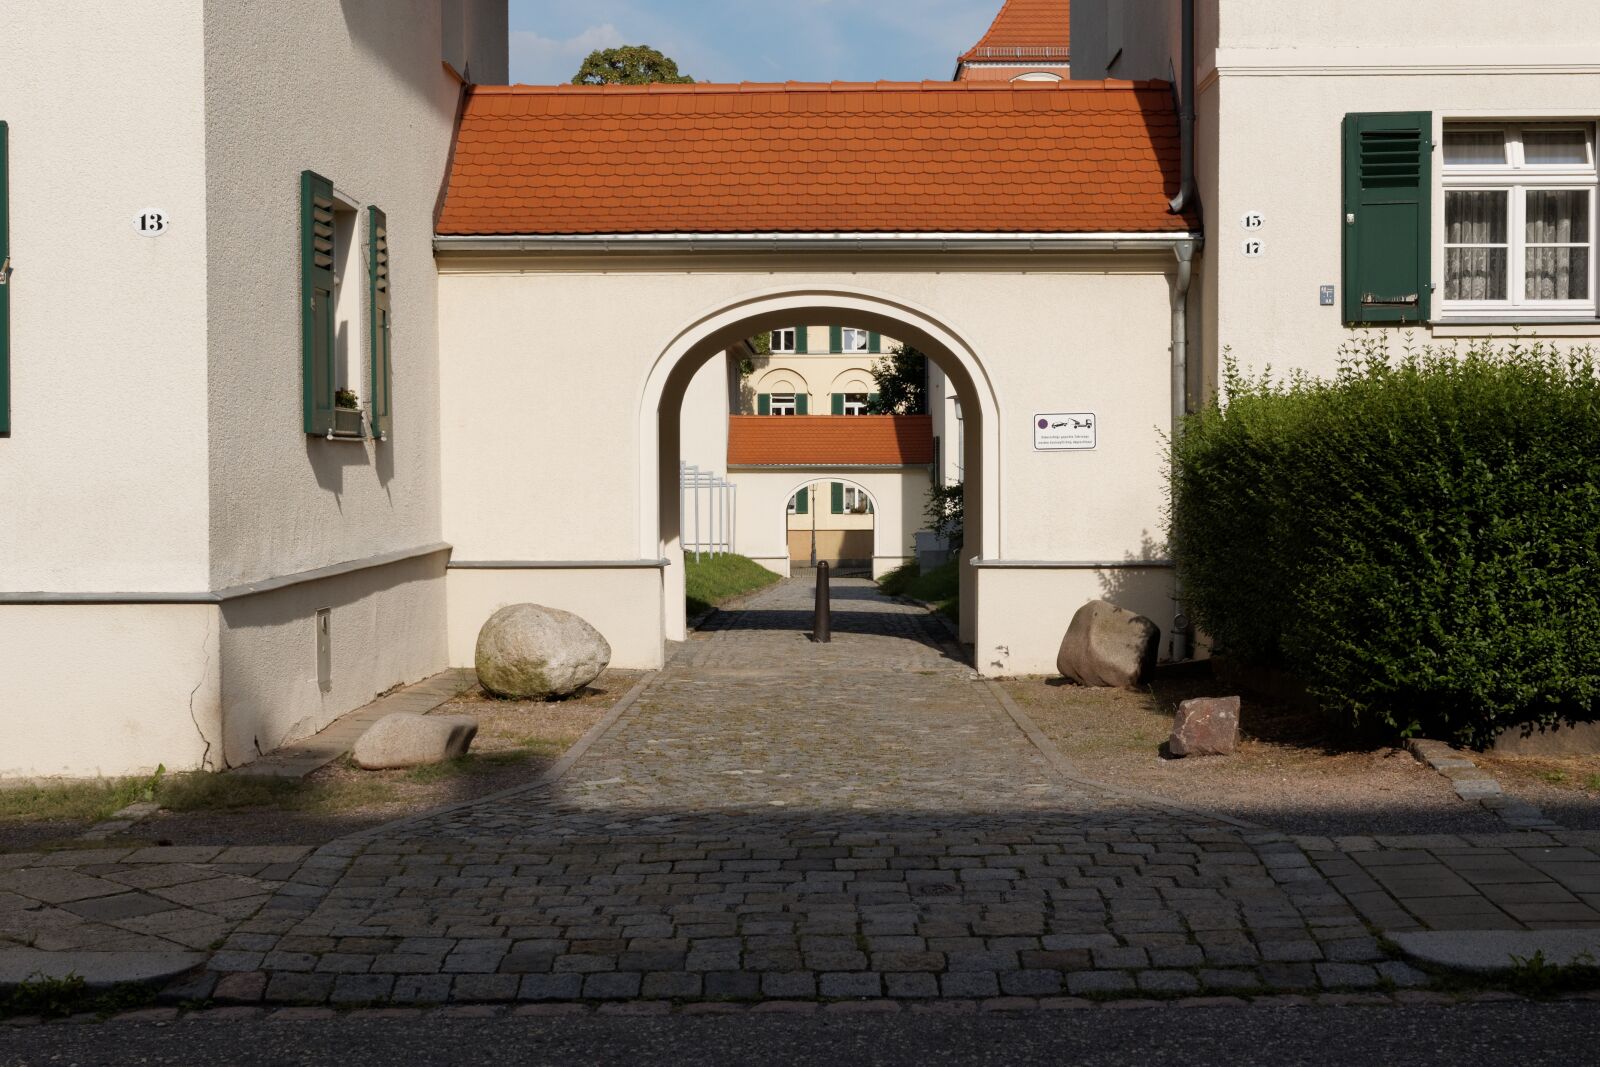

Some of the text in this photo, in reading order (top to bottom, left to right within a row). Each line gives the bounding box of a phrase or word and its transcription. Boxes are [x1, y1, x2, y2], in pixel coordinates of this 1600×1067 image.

[139, 213, 163, 231] 13
[1245, 215, 1262, 227] 15
[1245, 242, 1261, 254] 17
